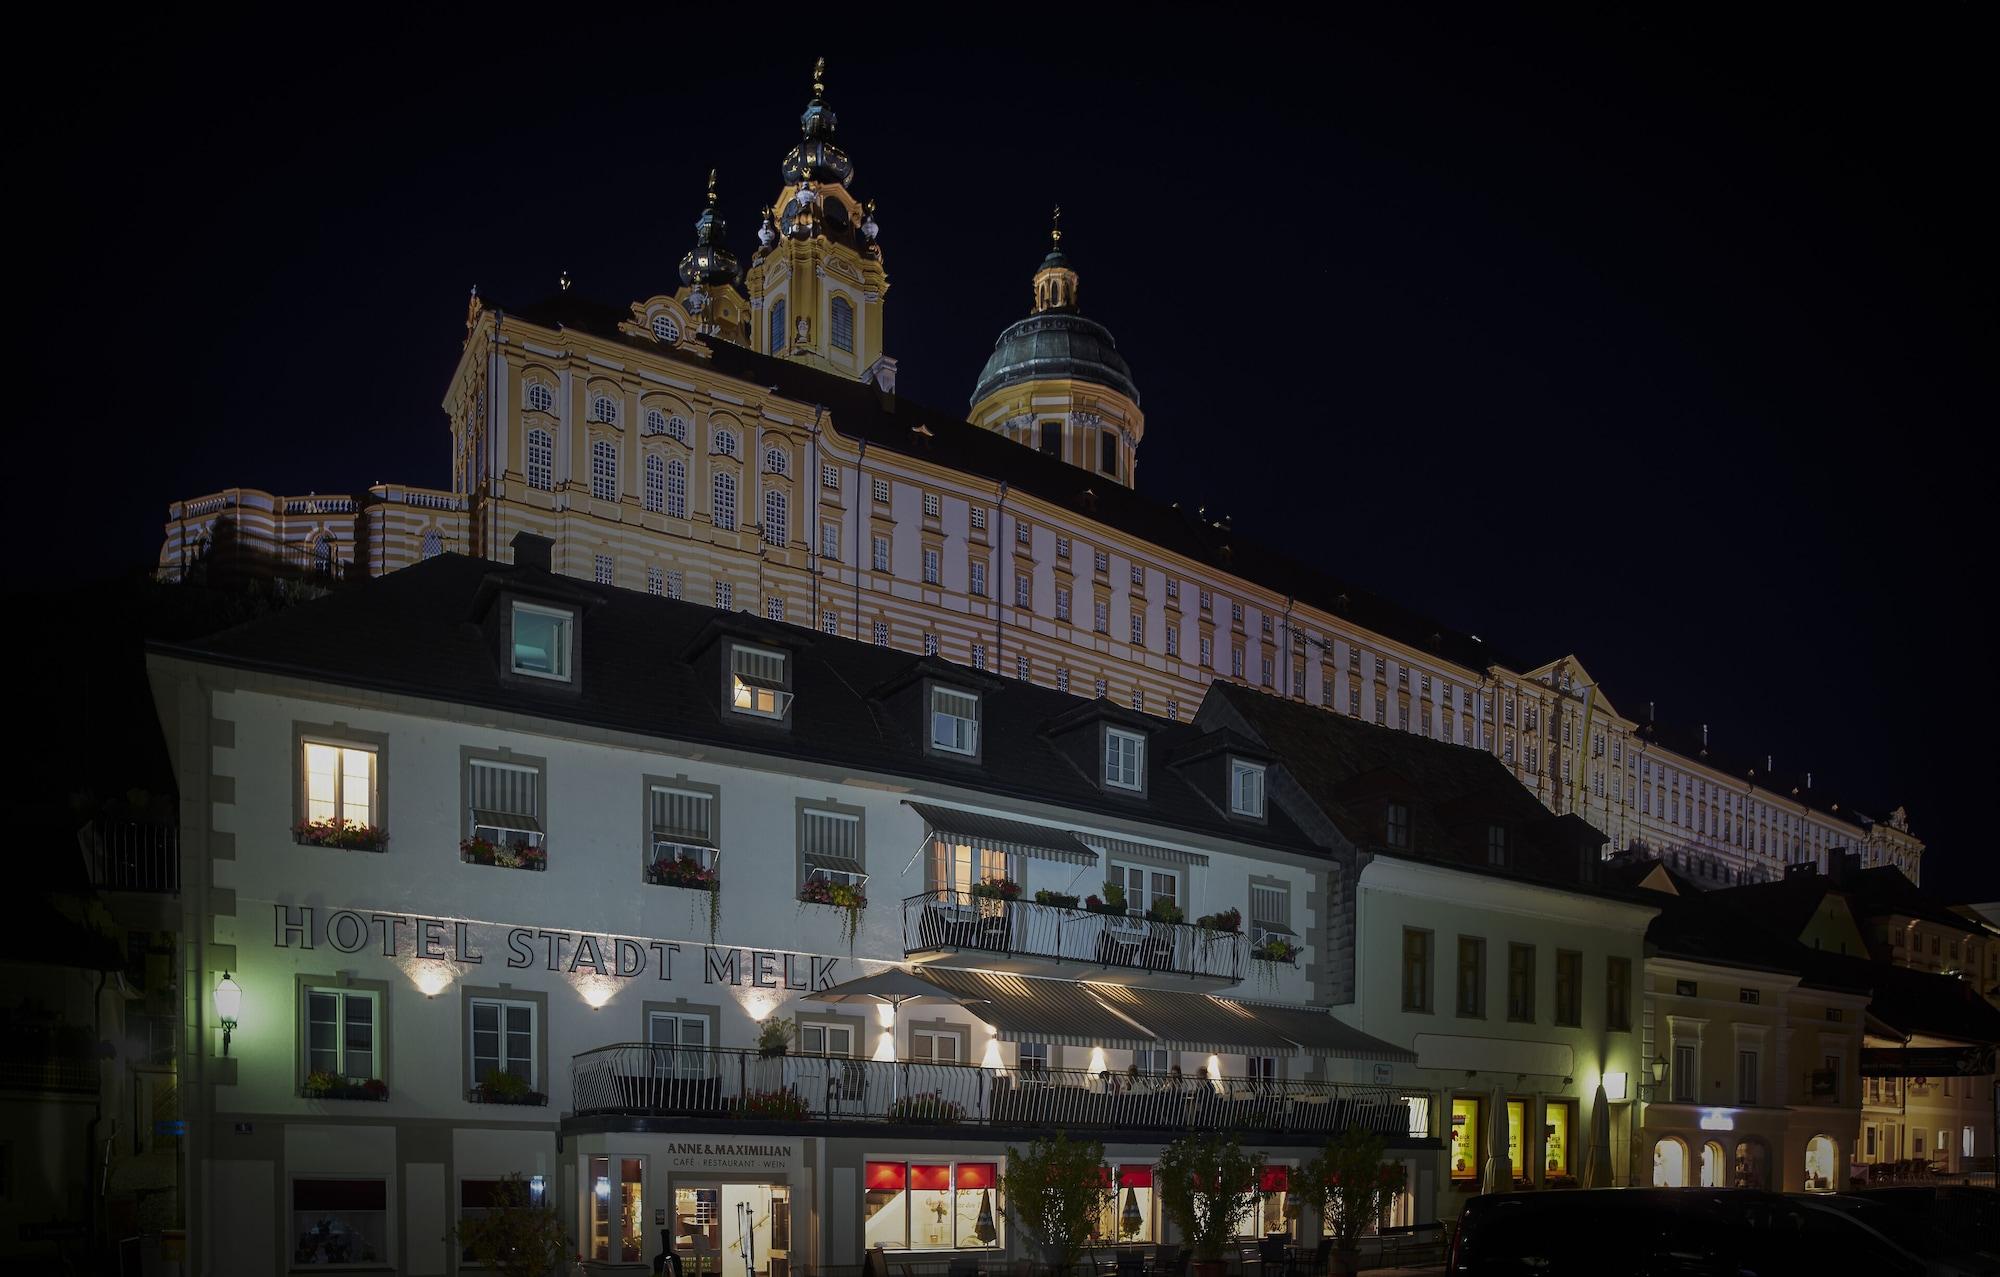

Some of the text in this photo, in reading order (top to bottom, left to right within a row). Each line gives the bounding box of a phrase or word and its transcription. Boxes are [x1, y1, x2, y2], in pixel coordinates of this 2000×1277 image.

[274, 904, 840, 993] HOTEL STADT MELK
[667, 1143, 792, 1157] ANNE&MAXIMILIAN
[703, 1159, 756, 1169] RESTAURANT
[763, 1160, 786, 1169] WEIN
